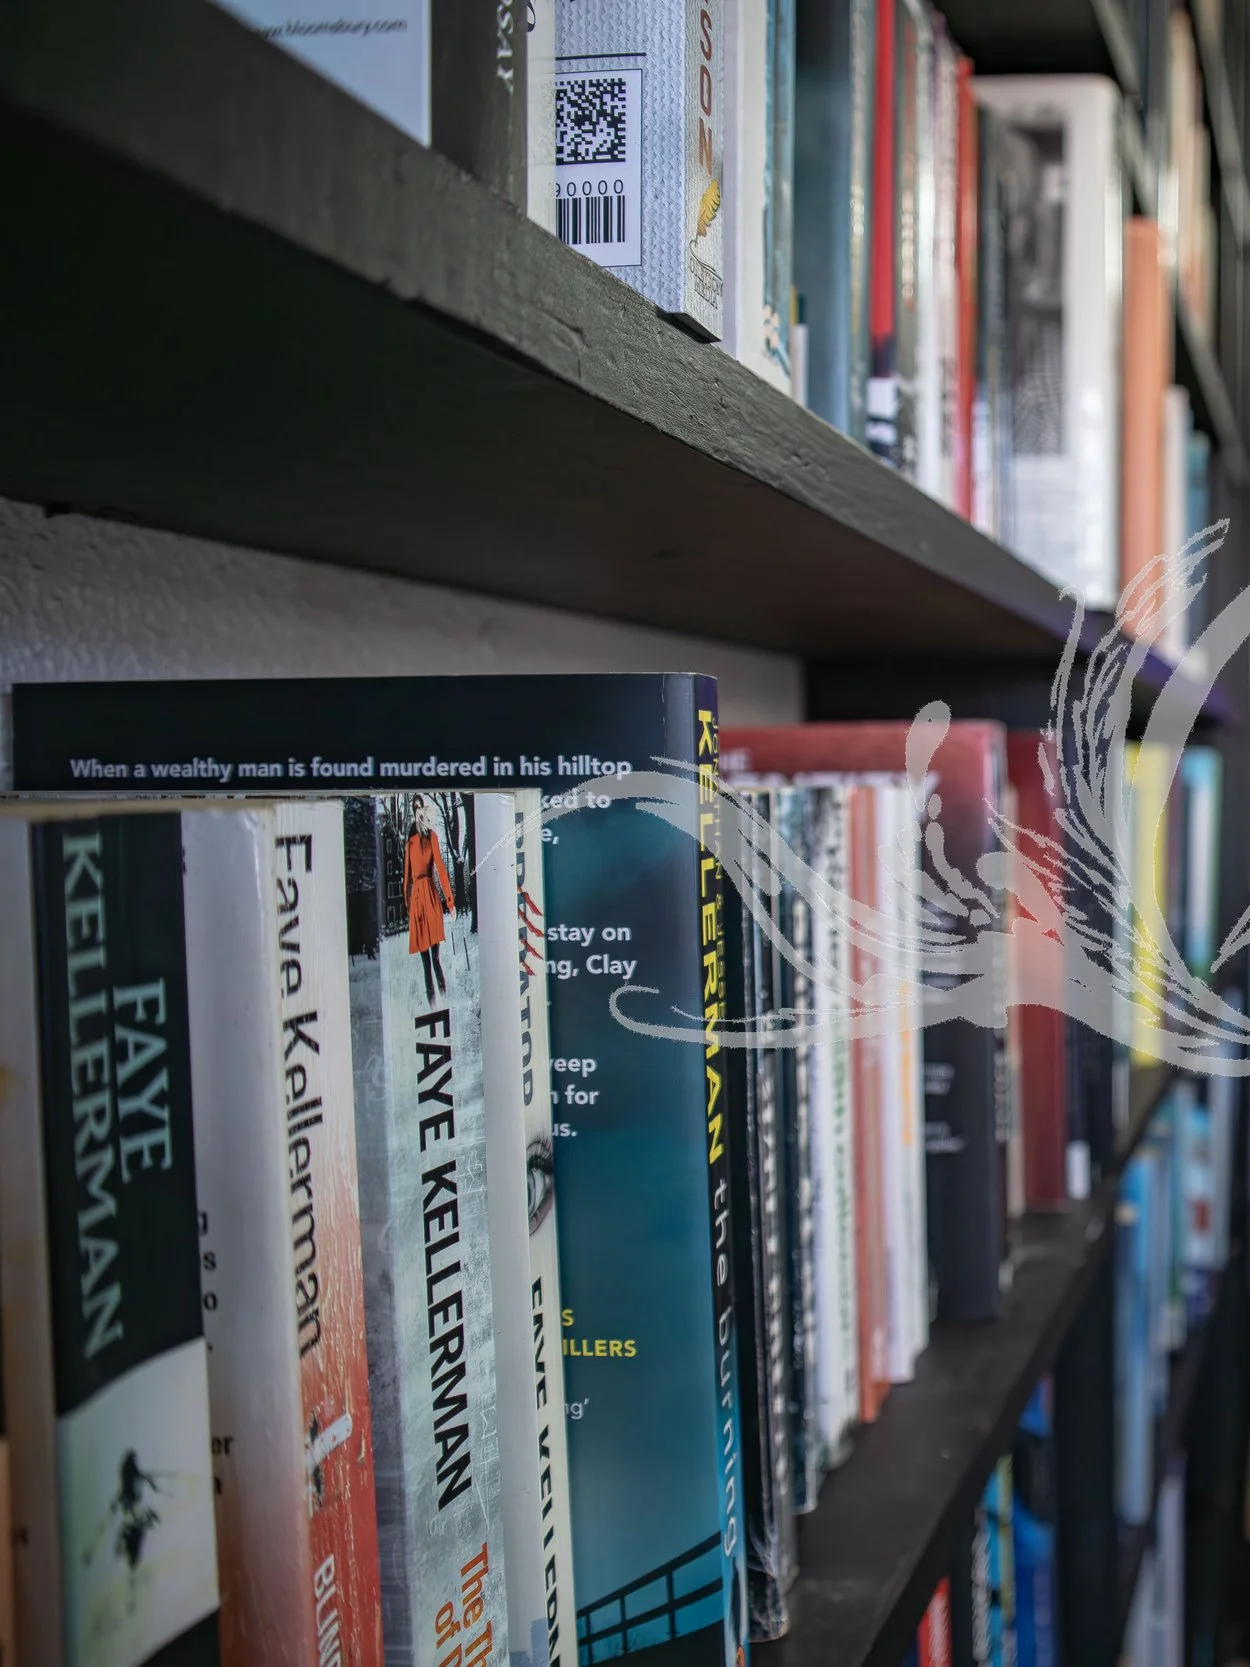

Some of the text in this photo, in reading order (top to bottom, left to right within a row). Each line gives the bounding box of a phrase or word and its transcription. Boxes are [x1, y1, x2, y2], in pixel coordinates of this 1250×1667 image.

[699, 0, 713, 177] SON
[70, 755, 632, 783] When a wealthy man is found murdered in his hilltop
[585, 793, 611, 808] to
[547, 924, 632, 947] stay on
[586, 954, 637, 979] Clay
[698, 709, 724, 1164] KELLERMAN
[63, 832, 123, 1359] KELLERMAN
[113, 976, 172, 1184] FAYE
[275, 833, 323, 1357] Faye Kellerman
[564, 1084, 599, 1105] for
[414, 1007, 472, 1512] FAYE KELLERMAN
[713, 1177, 738, 1558] the burning
[435, 1600, 461, 1649] of
[460, 1541, 489, 1629] The
